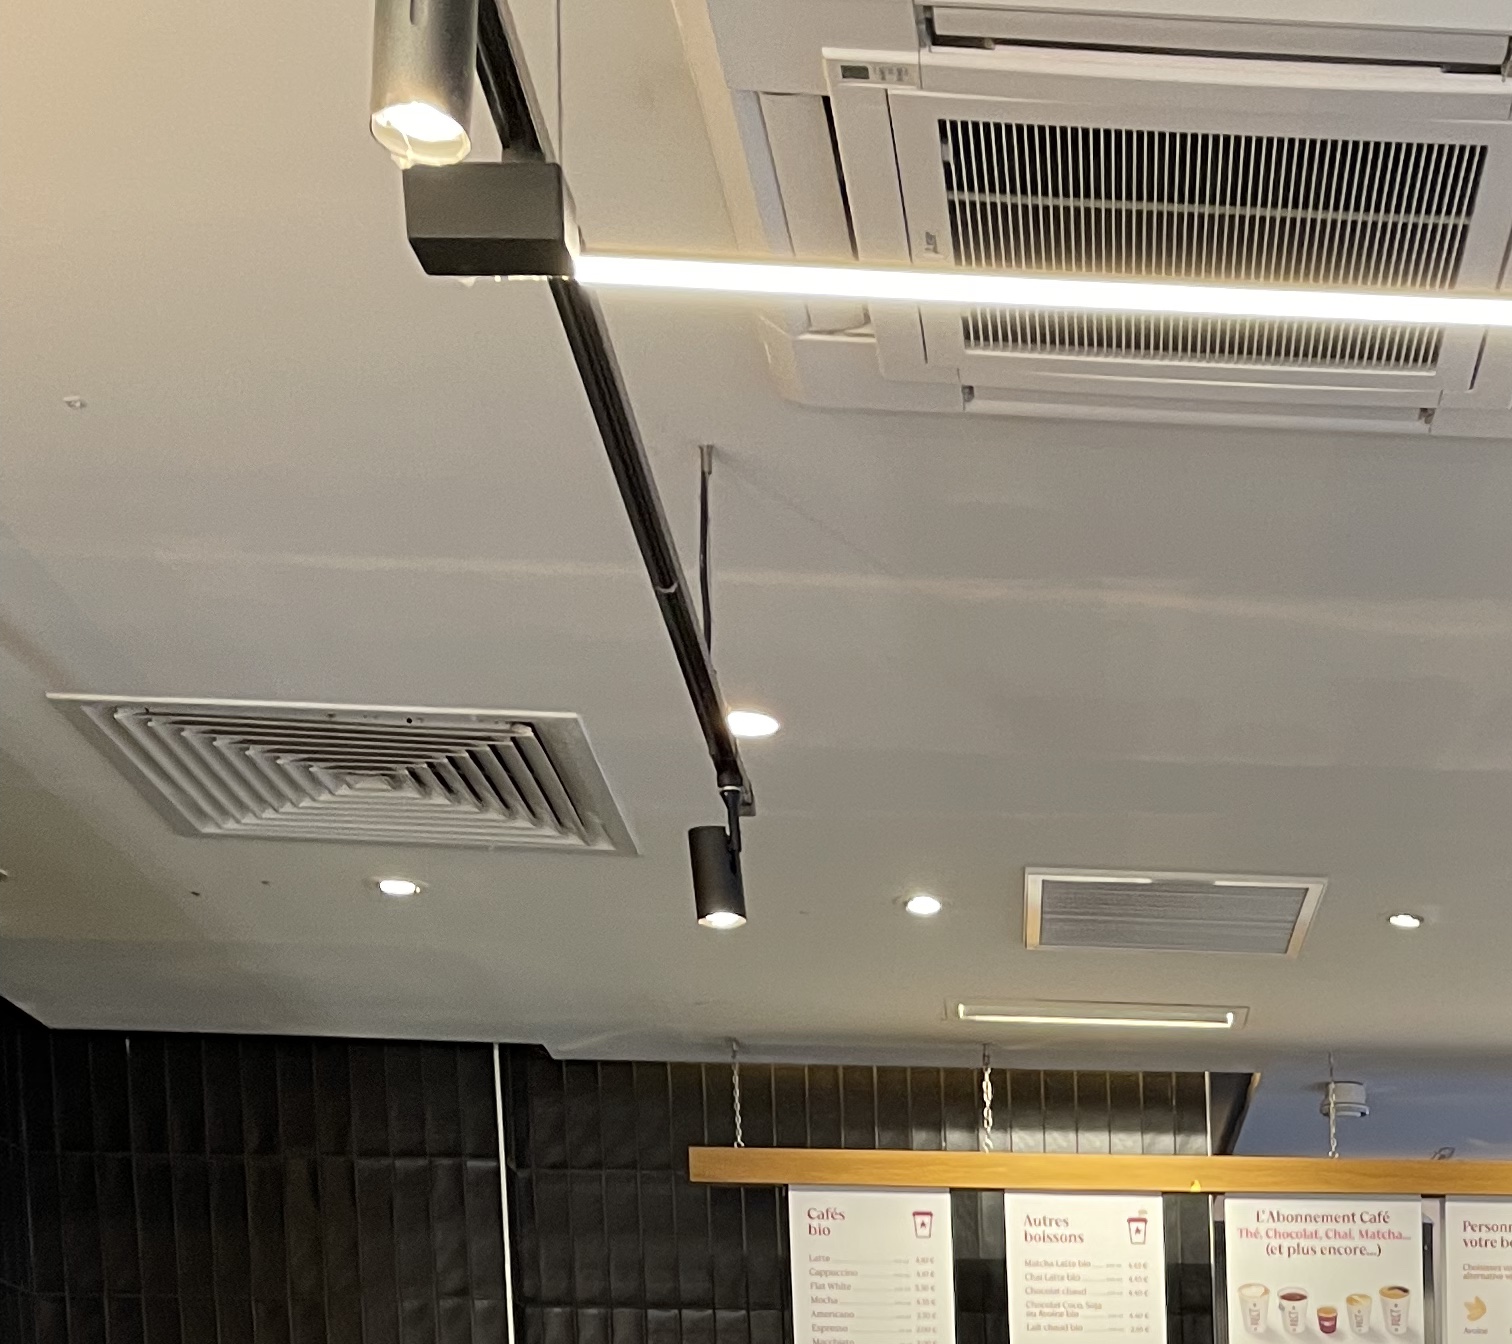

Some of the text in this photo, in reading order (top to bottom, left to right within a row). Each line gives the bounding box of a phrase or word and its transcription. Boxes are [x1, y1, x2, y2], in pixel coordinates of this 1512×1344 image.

[807, 1207, 845, 1220] Cafés
[1256, 1210, 1390, 1224] L'Abonnement Café
[1024, 1214, 1069, 1227] Autres
[808, 1223, 831, 1236] bio
[1024, 1229, 1085, 1243] boissons
[1237, 1228, 1263, 1240] Thé,
[1265, 1228, 1322, 1241] Chocolat,
[1325, 1228, 1355, 1240] Chai,
[1463, 1237, 1497, 1248] votre
[1266, 1243, 1283, 1257] (et
[1287, 1243, 1317, 1258] plus
[810, 1282, 851, 1290] Flat White
[811, 1296, 838, 1304] Mocha
[811, 1310, 855, 1318] Americano
[811, 1324, 849, 1333] Espresso
